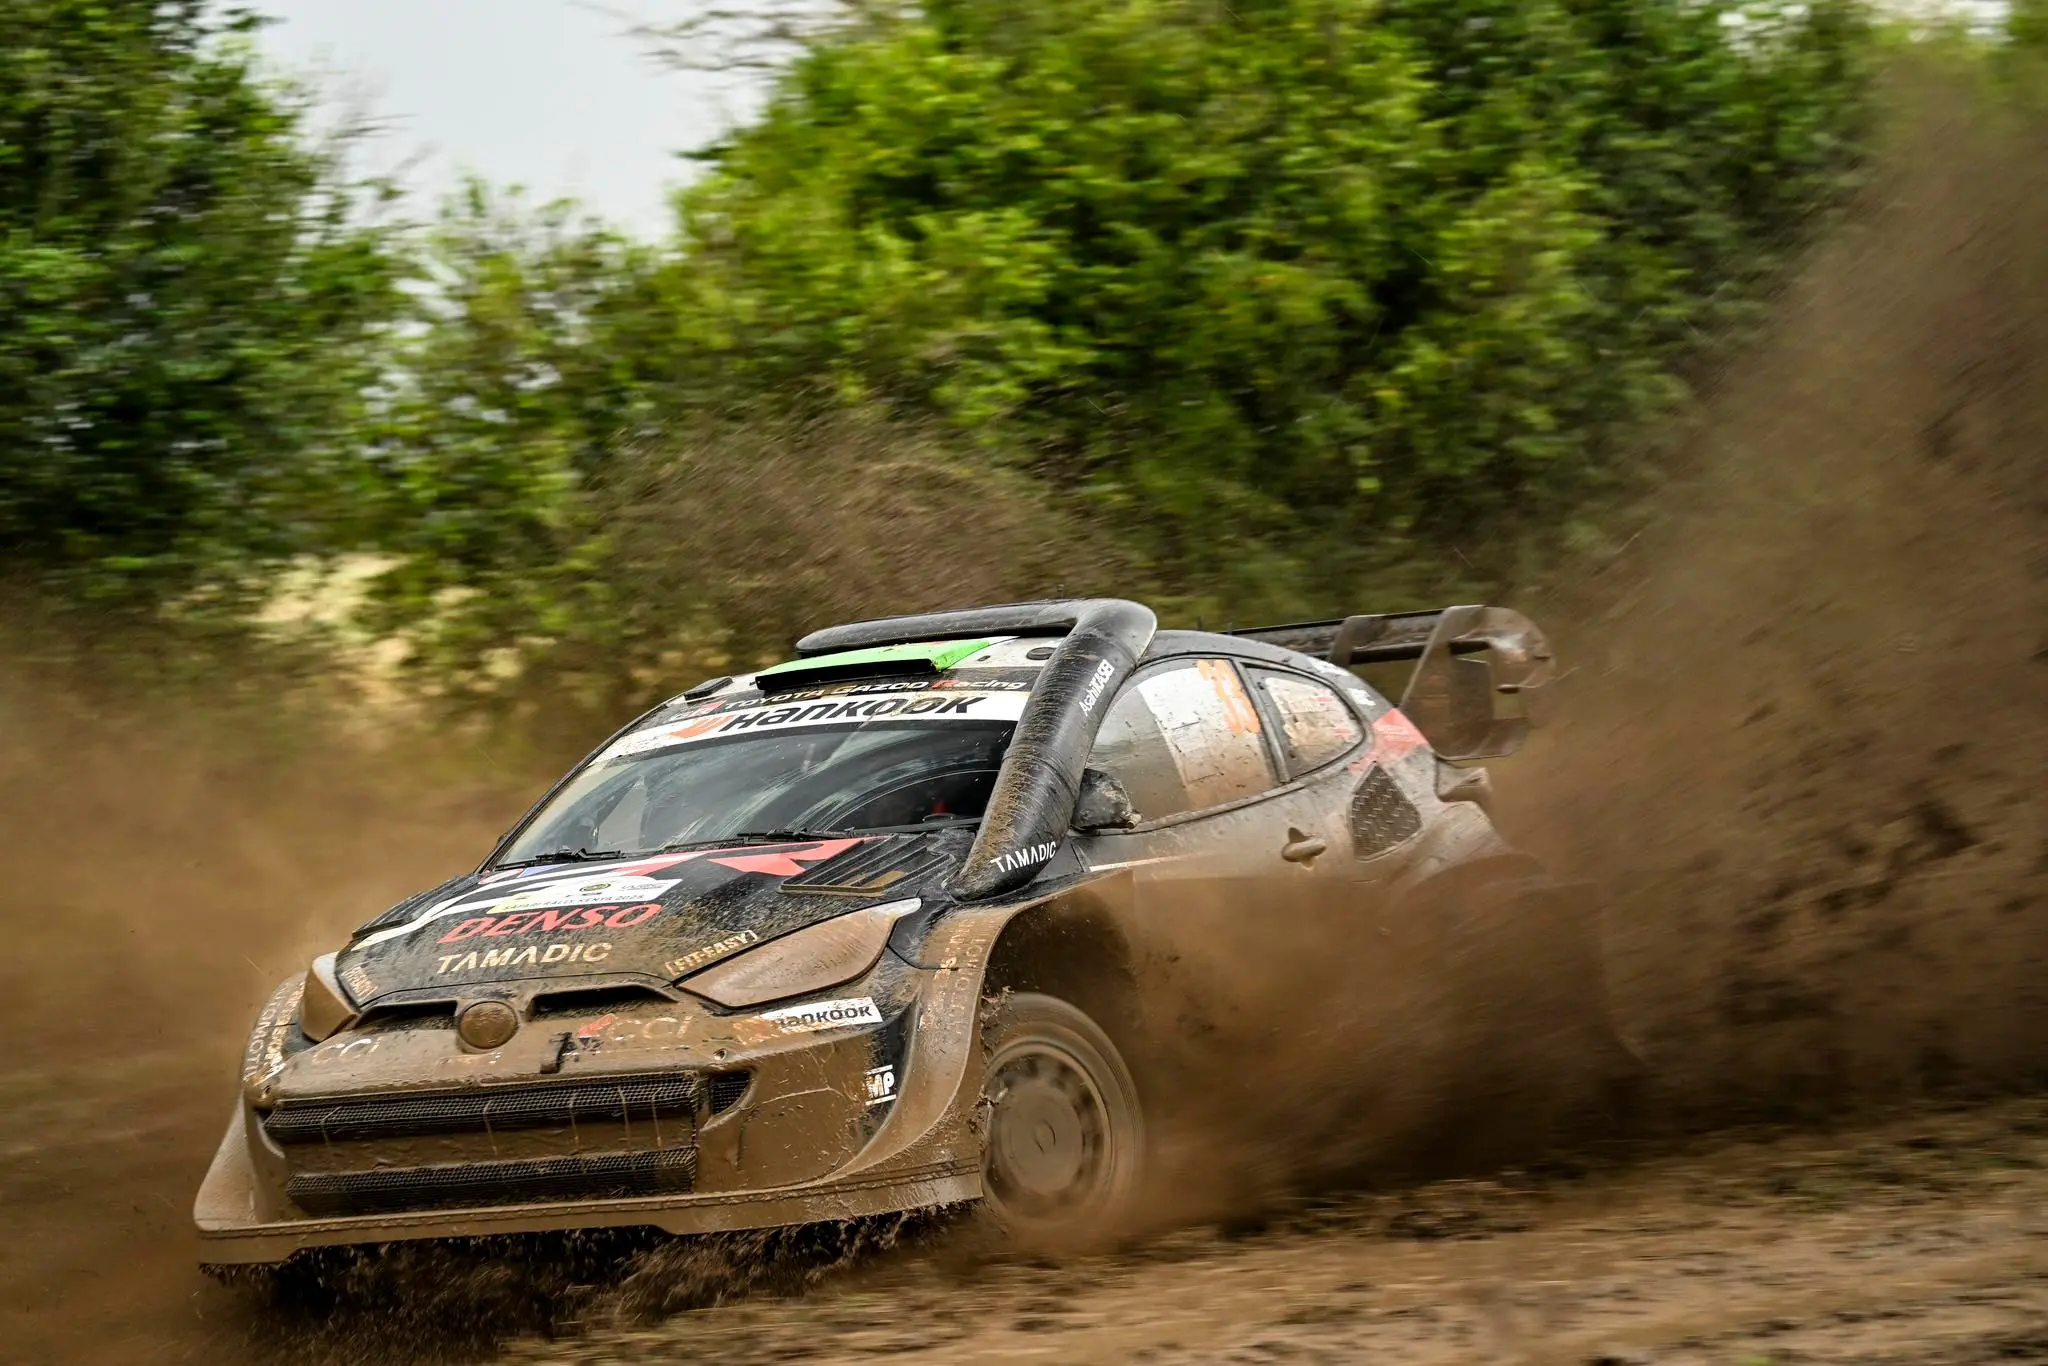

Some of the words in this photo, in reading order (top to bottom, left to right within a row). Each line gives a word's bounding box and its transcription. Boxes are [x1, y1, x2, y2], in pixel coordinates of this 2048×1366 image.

[725, 689, 825, 709] TOYOTA
[830, 680, 929, 695] GAZOO
[931, 679, 1028, 692] Racing
[990, 841, 1056, 873] TAMADIC
[437, 903, 663, 944] DENSO
[436, 942, 613, 974] TAMADIC
